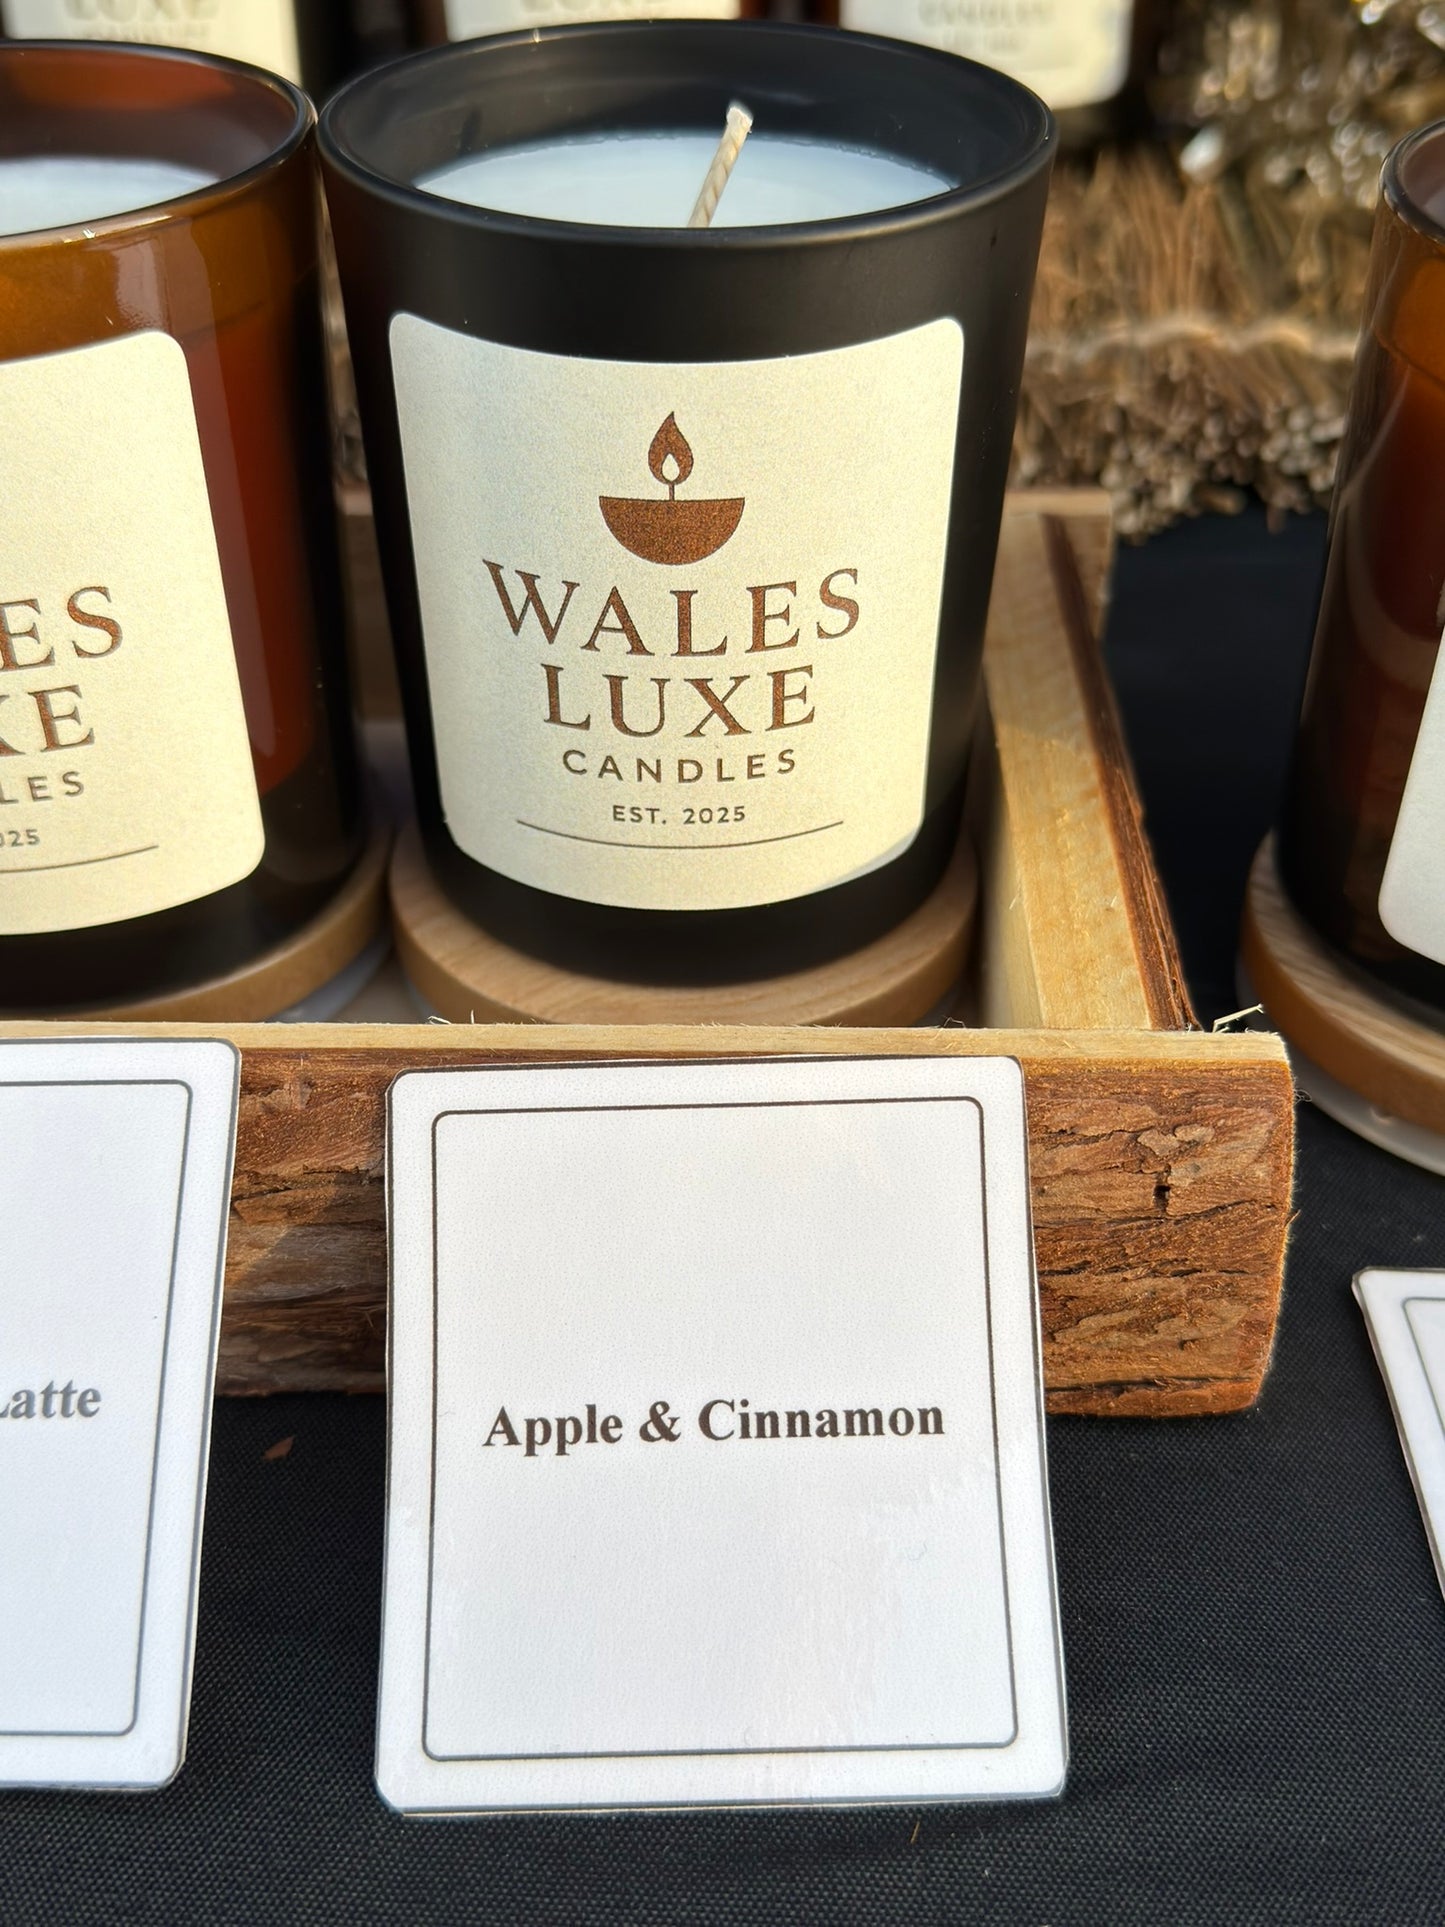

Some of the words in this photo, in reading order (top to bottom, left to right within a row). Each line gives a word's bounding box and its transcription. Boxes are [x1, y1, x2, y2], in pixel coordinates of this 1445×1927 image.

[0, 585, 123, 672] ES
[482, 559, 861, 657] WALES
[540, 663, 816, 738] LUXE
[562, 748, 796, 784] CANDLES
[612, 804, 667, 825] EST.
[683, 805, 746, 825] 2025
[483, 1404, 623, 1457] Apple
[639, 1400, 682, 1443] &
[698, 1399, 946, 1441] Cinnamon
